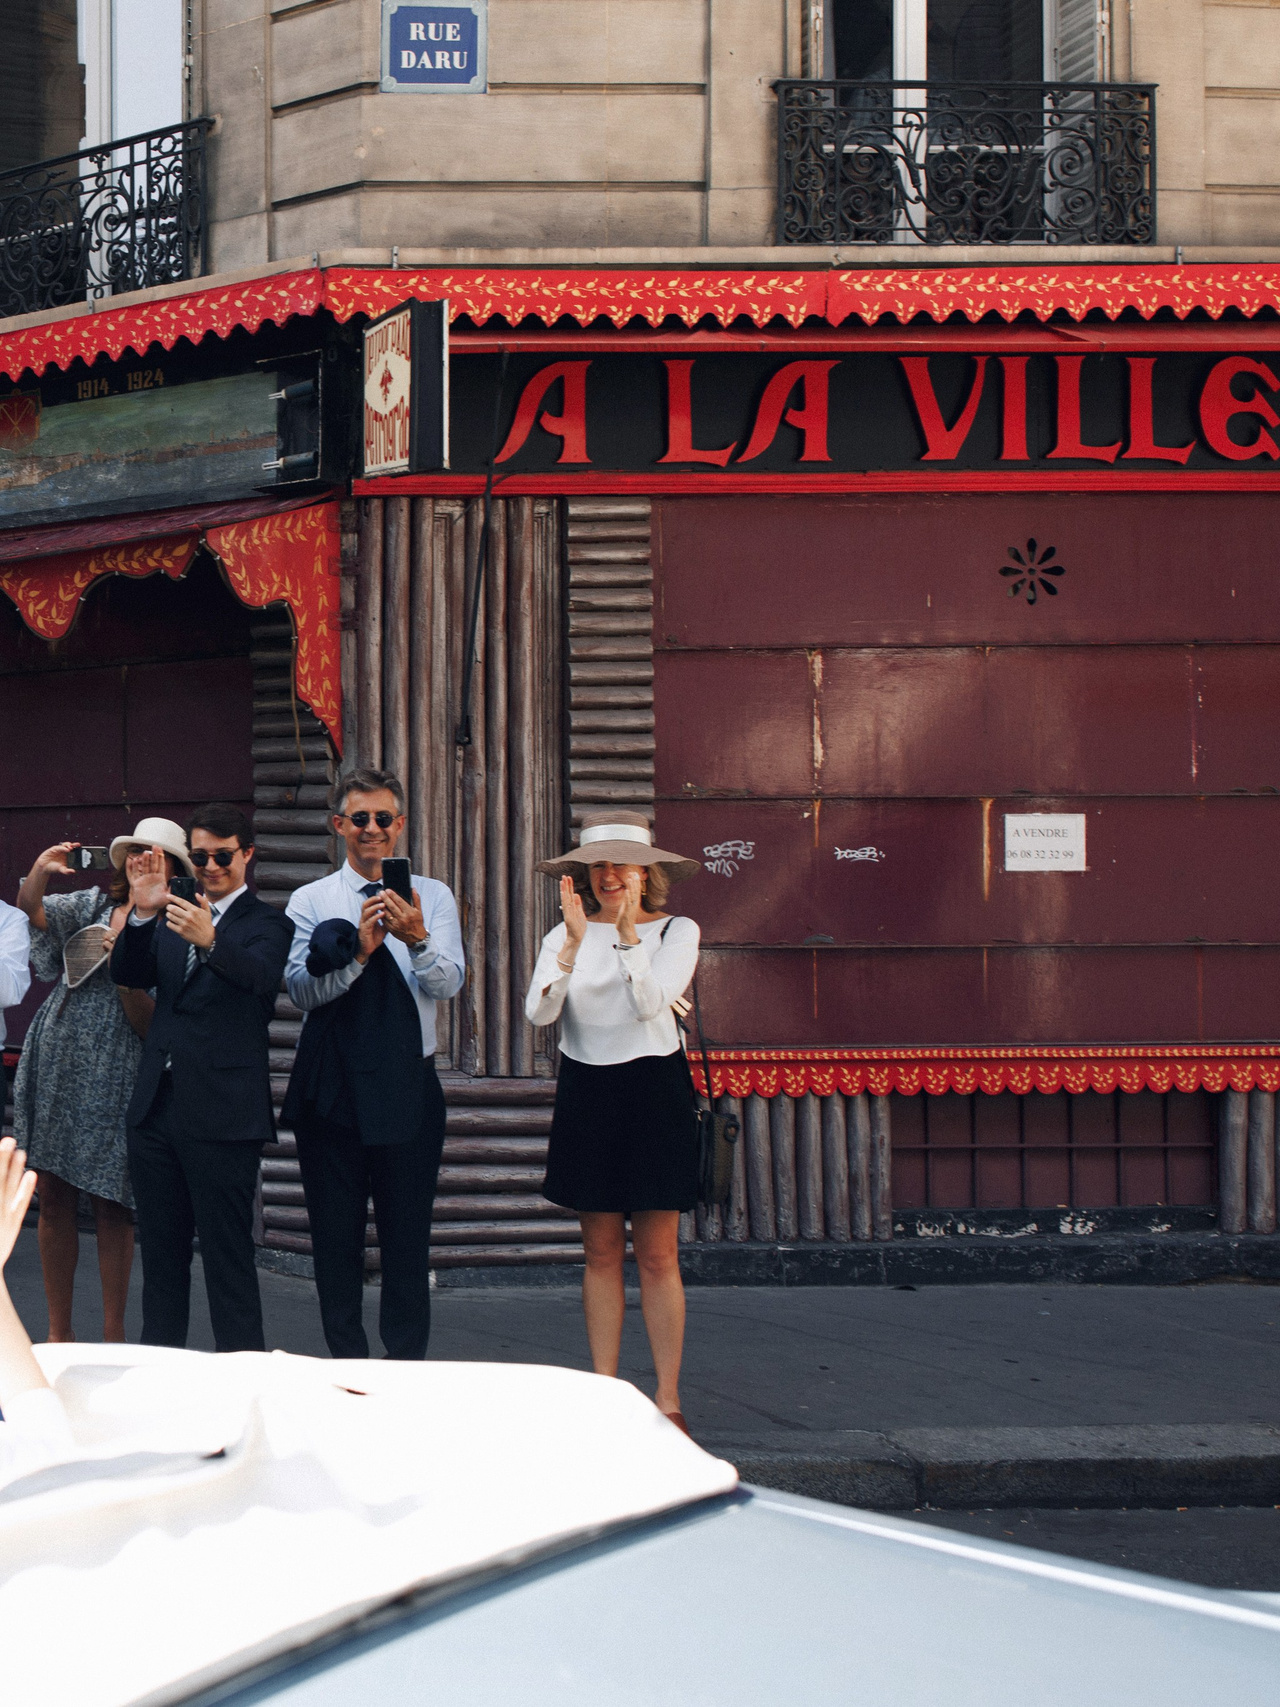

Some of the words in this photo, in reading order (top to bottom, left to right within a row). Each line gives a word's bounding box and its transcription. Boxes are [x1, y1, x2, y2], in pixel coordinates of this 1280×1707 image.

[409, 22, 461, 41] RUE
[400, 50, 468, 69] DARU
[77, 378, 109, 399] 1914
[126, 368, 165, 391] 1924
[493, 360, 593, 463] A
[655, 359, 843, 467] LA
[898, 355, 1280, 465] VILLE
[1023, 828, 1069, 838] VENDRE
[1007, 850, 1018, 859] 06
[1020, 850, 1032, 859] 08
[1034, 850, 1046, 859] 32
[1048, 850, 1060, 860] 32
[1062, 850, 1074, 859] 99
